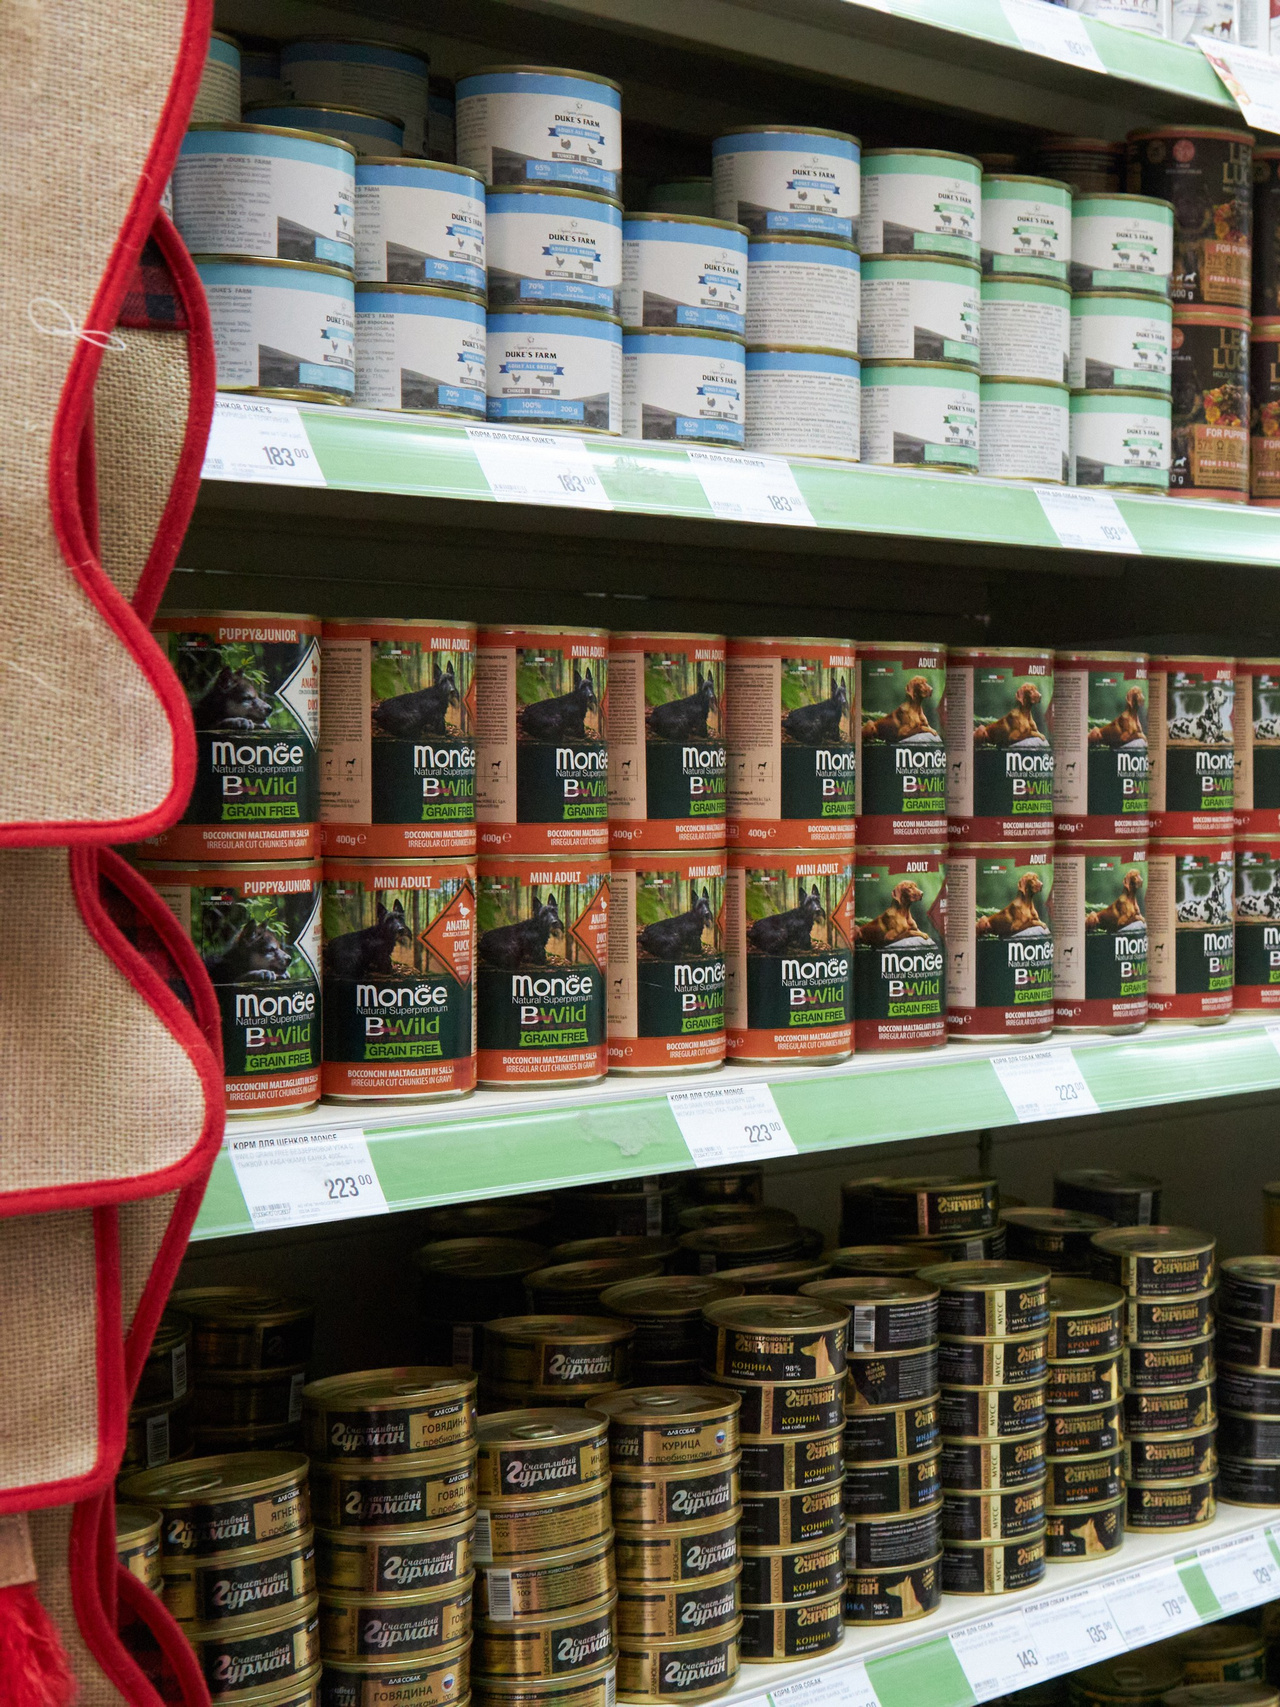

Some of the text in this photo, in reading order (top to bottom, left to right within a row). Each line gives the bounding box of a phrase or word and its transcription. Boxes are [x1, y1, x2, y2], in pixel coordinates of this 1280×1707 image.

[583, 118, 600, 128] FARM
[577, 237, 596, 246] FARM
[469, 430, 490, 439] КОРМ
[263, 445, 308, 467] 183 00
[557, 473, 595, 493] 183 00
[767, 494, 791, 512] 183
[219, 628, 296, 642] PUPPY&JUNIOR
[431, 637, 470, 650] MINI ADULT
[918, 657, 937, 669] ADULT
[212, 764, 304, 774] Natural Superpremium
[227, 805, 296, 818] GRAIN FREE
[203, 832, 246, 840] BOCCONCINI
[336, 834, 356, 846] 400g
[207, 841, 243, 849] IRREGULAR
[245, 840, 258, 848] CUT
[796, 863, 838, 875] MINI ADULT
[374, 876, 432, 888] MINI ADULT
[530, 872, 581, 883] MINI ADULT
[244, 879, 311, 893] PUPPY&JUNIOR
[446, 920, 470, 931] ANATRA
[454, 941, 469, 951] DUCK
[512, 995, 593, 1004] Natural Superpremium
[356, 1005, 448, 1015] Natural Superpremium
[524, 1032, 585, 1044] GRAIN FREE
[369, 1044, 438, 1056] GRAIN FREE
[250, 1055, 309, 1068] GRAIN FREE
[348, 1069, 387, 1077] BOCCONCINI
[389, 1068, 431, 1077] MALTAGLIATI
[351, 1078, 384, 1087] IRREGULAR
[385, 1078, 397, 1086] CUT
[398, 1076, 428, 1086] CHUNKIES
[670, 1094, 688, 1102] КОРМ
[1055, 1083, 1077, 1102] 223
[744, 1122, 781, 1143] 223 00
[233, 1141, 256, 1150] КОРМ
[258, 1139, 275, 1148] ДЛЯ
[324, 1174, 372, 1199] 223 00
[731, 1362, 772, 1372] КОНИНА
[422, 1416, 466, 1435] ГОВЯДИНА
[781, 1414, 820, 1425] КОНИНА
[662, 1439, 701, 1451] КУРИЦА
[793, 1578, 829, 1592] КОНИНА
[1162, 1599, 1181, 1618] 179
[1086, 1624, 1106, 1644] 135
[1016, 1650, 1038, 1670] 143
[402, 1675, 421, 1683] СОБАК
[374, 1685, 433, 1702] ГОВЯДИНА
[774, 1688, 790, 1697] КОРМ
